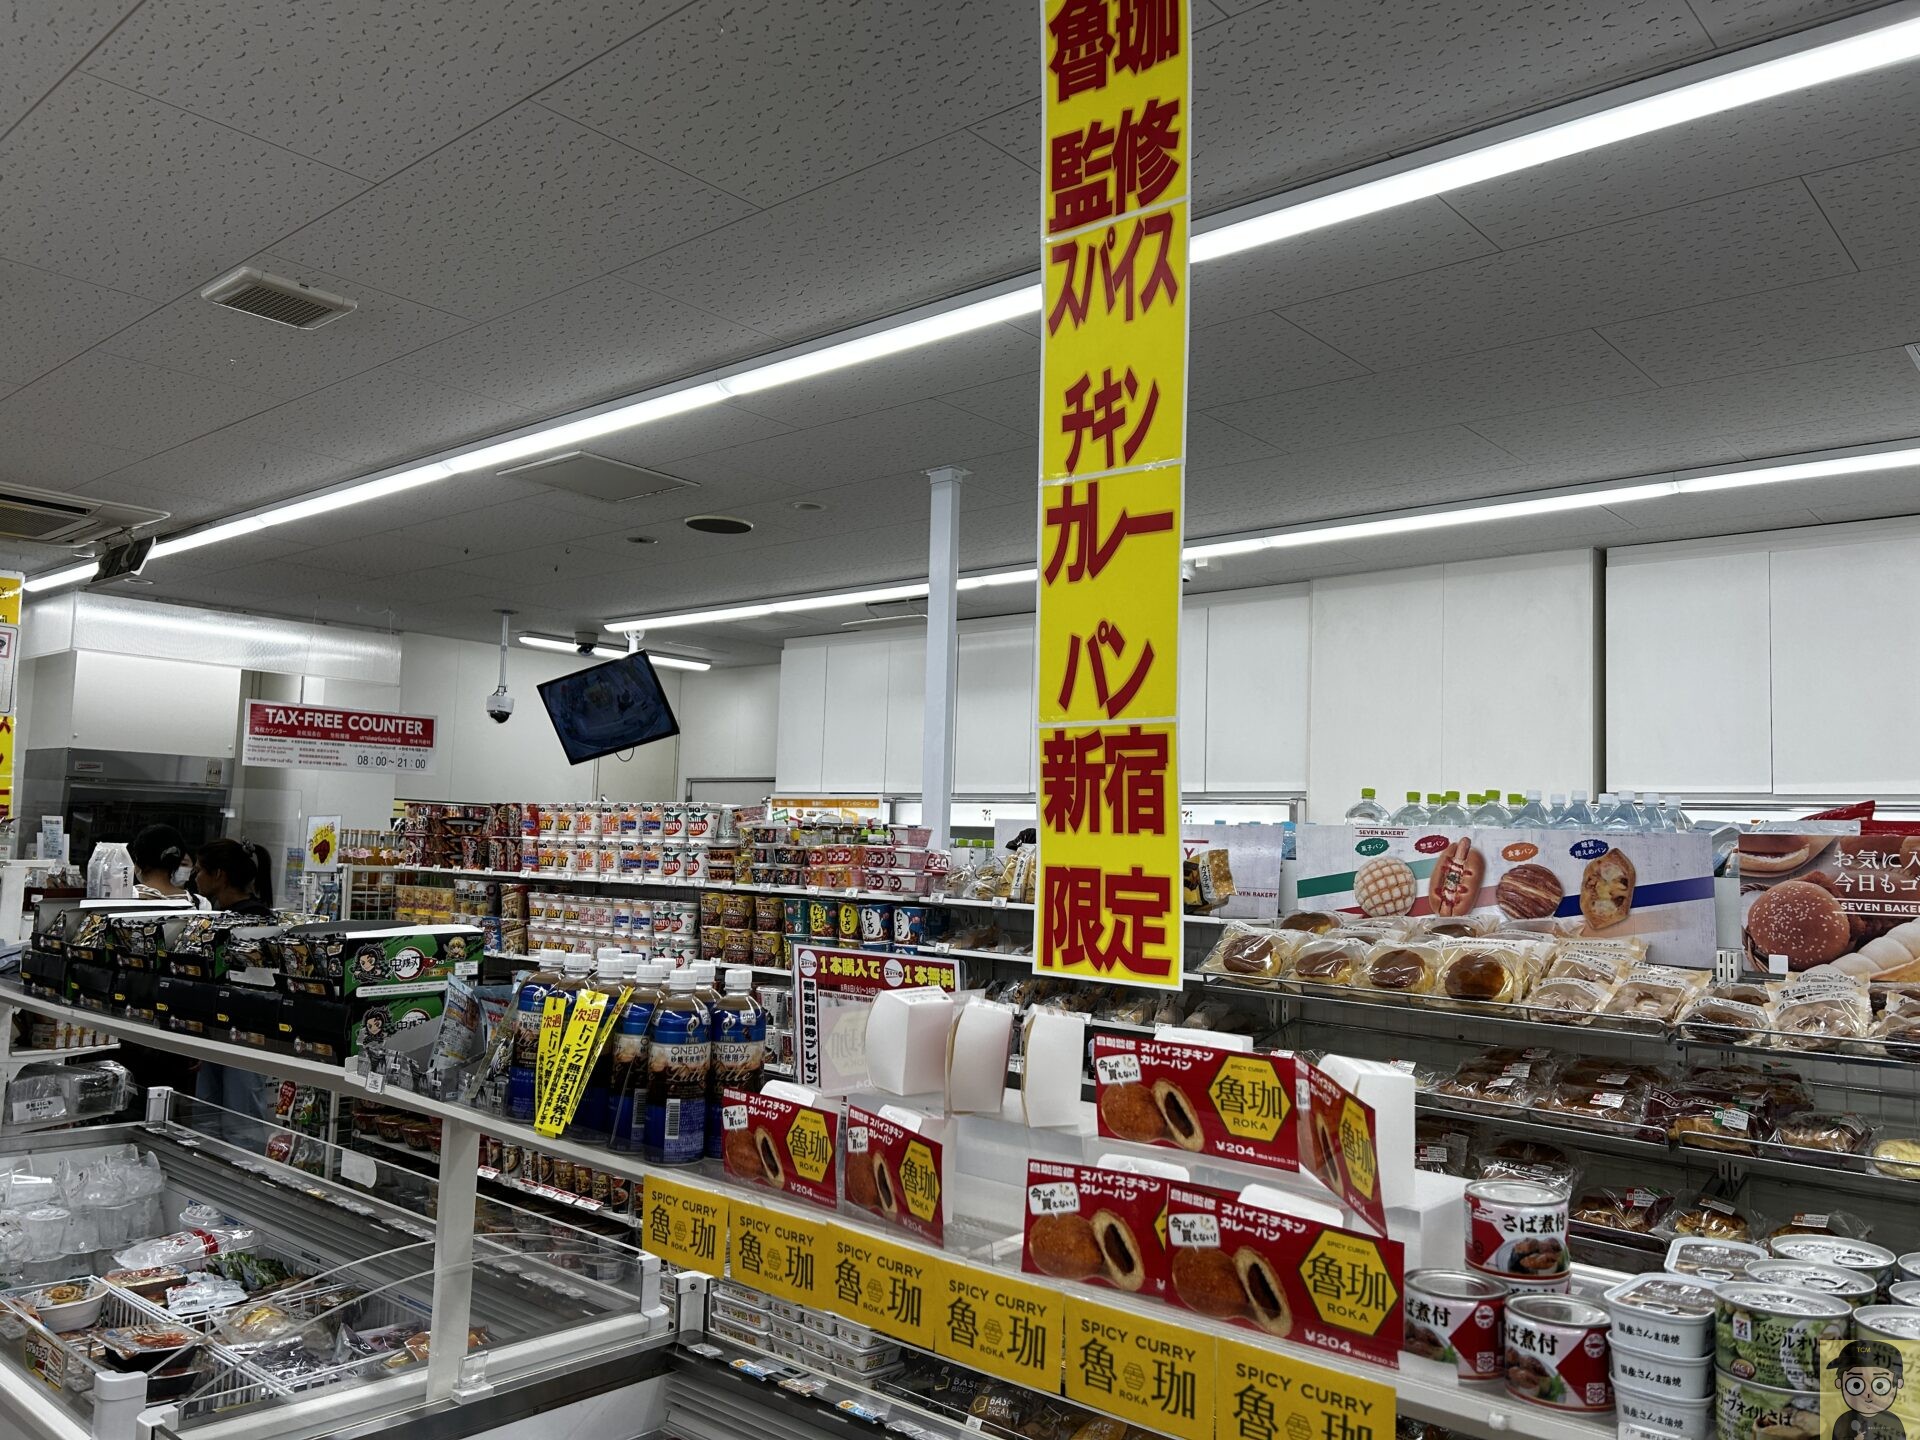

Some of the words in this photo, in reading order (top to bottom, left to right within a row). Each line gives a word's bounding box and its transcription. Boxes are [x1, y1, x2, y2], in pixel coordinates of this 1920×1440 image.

[1048, 97, 1181, 234] 監修
[1048, 210, 1179, 337] スパイス
[1061, 366, 1161, 474] チキン
[1044, 481, 1175, 587] カレー
[1057, 619, 1155, 720] パン
[265, 708, 343, 729] TAX-FREE
[348, 716, 423, 735] COUNTER
[1041, 725, 1169, 836] 新宿
[664, 823, 681, 831] MATO
[809, 852, 823, 864] ンタン
[1841, 902, 1880, 911] SEVEN
[1042, 865, 1171, 979] 限定
[819, 955, 880, 979] 1本購入で
[521, 1014, 543, 1023] ONED
[543, 1014, 561, 1029] 次週
[574, 1007, 601, 1023] 次週
[803, 981, 818, 1085] 無料引換券プレゼン
[671, 1045, 708, 1055] ONEDAY
[712, 1053, 750, 1063] 糖不使用ラテ
[1140, 1043, 1214, 1062] スパイスチキン
[1098, 1059, 1120, 1072] 今しか
[1140, 1055, 1192, 1071] カレーパン
[549, 1024, 594, 1127] ドリンク無料引換券付
[668, 1066, 705, 1083] Latt
[749, 1095, 792, 1113] スパイスチキン
[1215, 1075, 1283, 1120] 魯珈
[1652, 1091, 1680, 1107] EVEN
[748, 1106, 779, 1120] カレーパン
[870, 1118, 904, 1140] スパイスチキン
[1232, 1117, 1269, 1132] ROKA
[790, 1124, 829, 1165] 魯珈
[868, 1129, 894, 1146] カレーパン
[1215, 1141, 1256, 1158] ¥204
[799, 1161, 821, 1175] ROKA
[790, 1182, 813, 1197] ¥204
[1080, 1171, 1161, 1193] スパイスチキン
[1030, 1188, 1056, 1201] 今しか
[1079, 1184, 1138, 1202] カレーパン
[651, 1190, 678, 1206] SPICY
[682, 1200, 718, 1219] CURRY
[1041, 1197, 1077, 1211] 買えない!
[1171, 1217, 1196, 1230] 今しか
[1220, 1216, 1281, 1242] カレーパン
[1221, 1203, 1307, 1234] スパイスチキン
[1501, 1213, 1565, 1234] さば煮付
[739, 1215, 771, 1234] SPICY
[774, 1226, 815, 1248] CURRY
[1181, 1229, 1217, 1244] 買えない!
[671, 1241, 688, 1254] ROKA
[1326, 1240, 1347, 1251] SPICY
[1346, 1245, 1371, 1256] CURRY
[837, 1241, 872, 1264] SPICY
[876, 1256, 923, 1280] CURRY
[764, 1269, 784, 1284] ROKA
[1307, 1252, 1388, 1312] 魯珈
[949, 1279, 989, 1302] SPICY
[994, 1293, 1048, 1318] CURRY
[862, 1302, 886, 1317] ROKA
[1327, 1302, 1369, 1323] ROKA
[1405, 1299, 1451, 1328] ば煮付
[1081, 1318, 1129, 1345] SPICY
[1135, 1335, 1197, 1364] CURRY
[1304, 1328, 1351, 1354] ¥204
[1618, 1322, 1681, 1346] 国産さんま蒲焼
[979, 1344, 1006, 1360] ROKA
[1620, 1363, 1682, 1387] 国産さんま蒲焼
[1118, 1389, 1149, 1408] ROKA
[1236, 1362, 1293, 1392] SPICY
[1300, 1383, 1374, 1418] CURRY
[1622, 1404, 1684, 1430] 国産さんま蒲焼
[1717, 1389, 1793, 1427] リーブオイルさば
